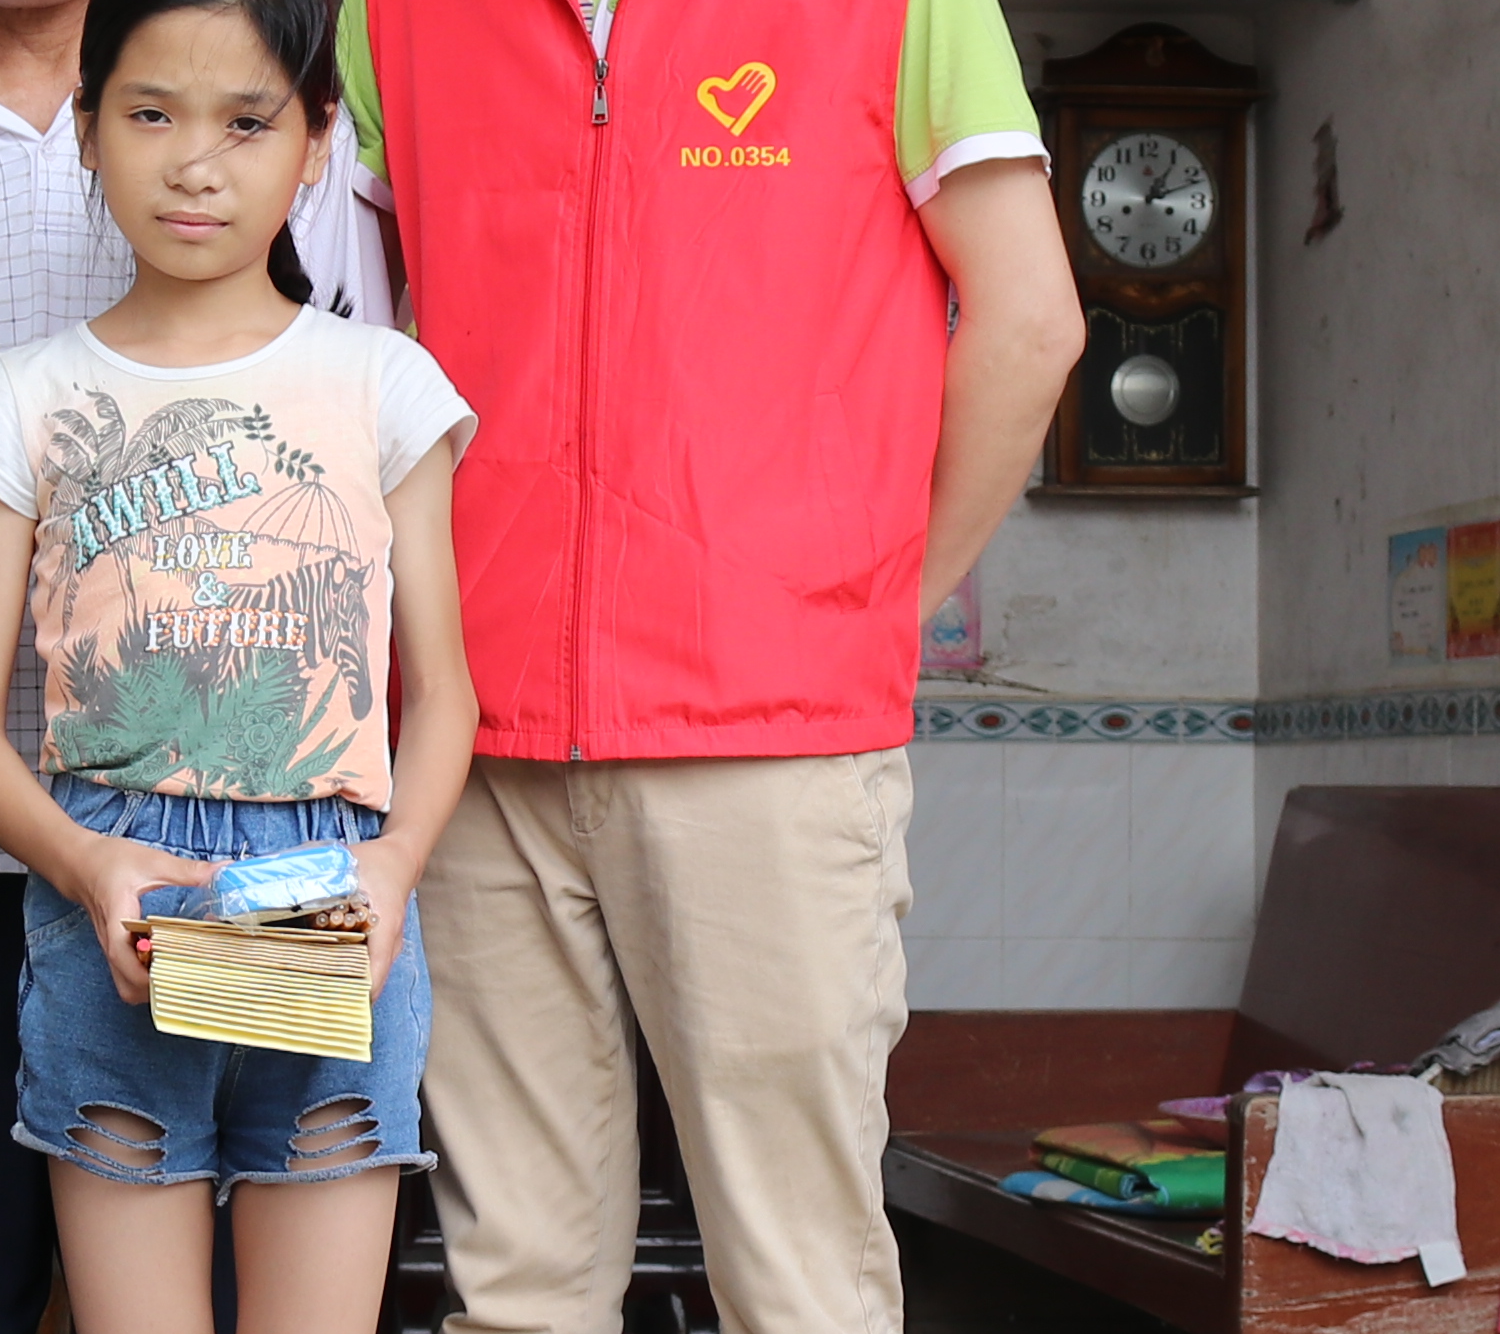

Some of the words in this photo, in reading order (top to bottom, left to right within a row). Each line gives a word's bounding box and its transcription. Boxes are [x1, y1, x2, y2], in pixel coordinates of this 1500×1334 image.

[680, 145, 791, 168] NO.0354
[1115, 148, 1132, 164] 11
[1138, 141, 1158, 158] 12
[1097, 166, 1115, 182] 10
[1091, 192, 1106, 207] 9
[1191, 192, 1206, 209] 3
[1097, 217, 1113, 233] 8
[1183, 218, 1197, 235] 4
[1118, 236, 1131, 252] 7
[1141, 243, 1156, 260] 6
[1166, 237, 1181, 253] 5
[151, 532, 253, 572] LOVE
[193, 572, 230, 607] &
[144, 607, 310, 652] FUTURE
